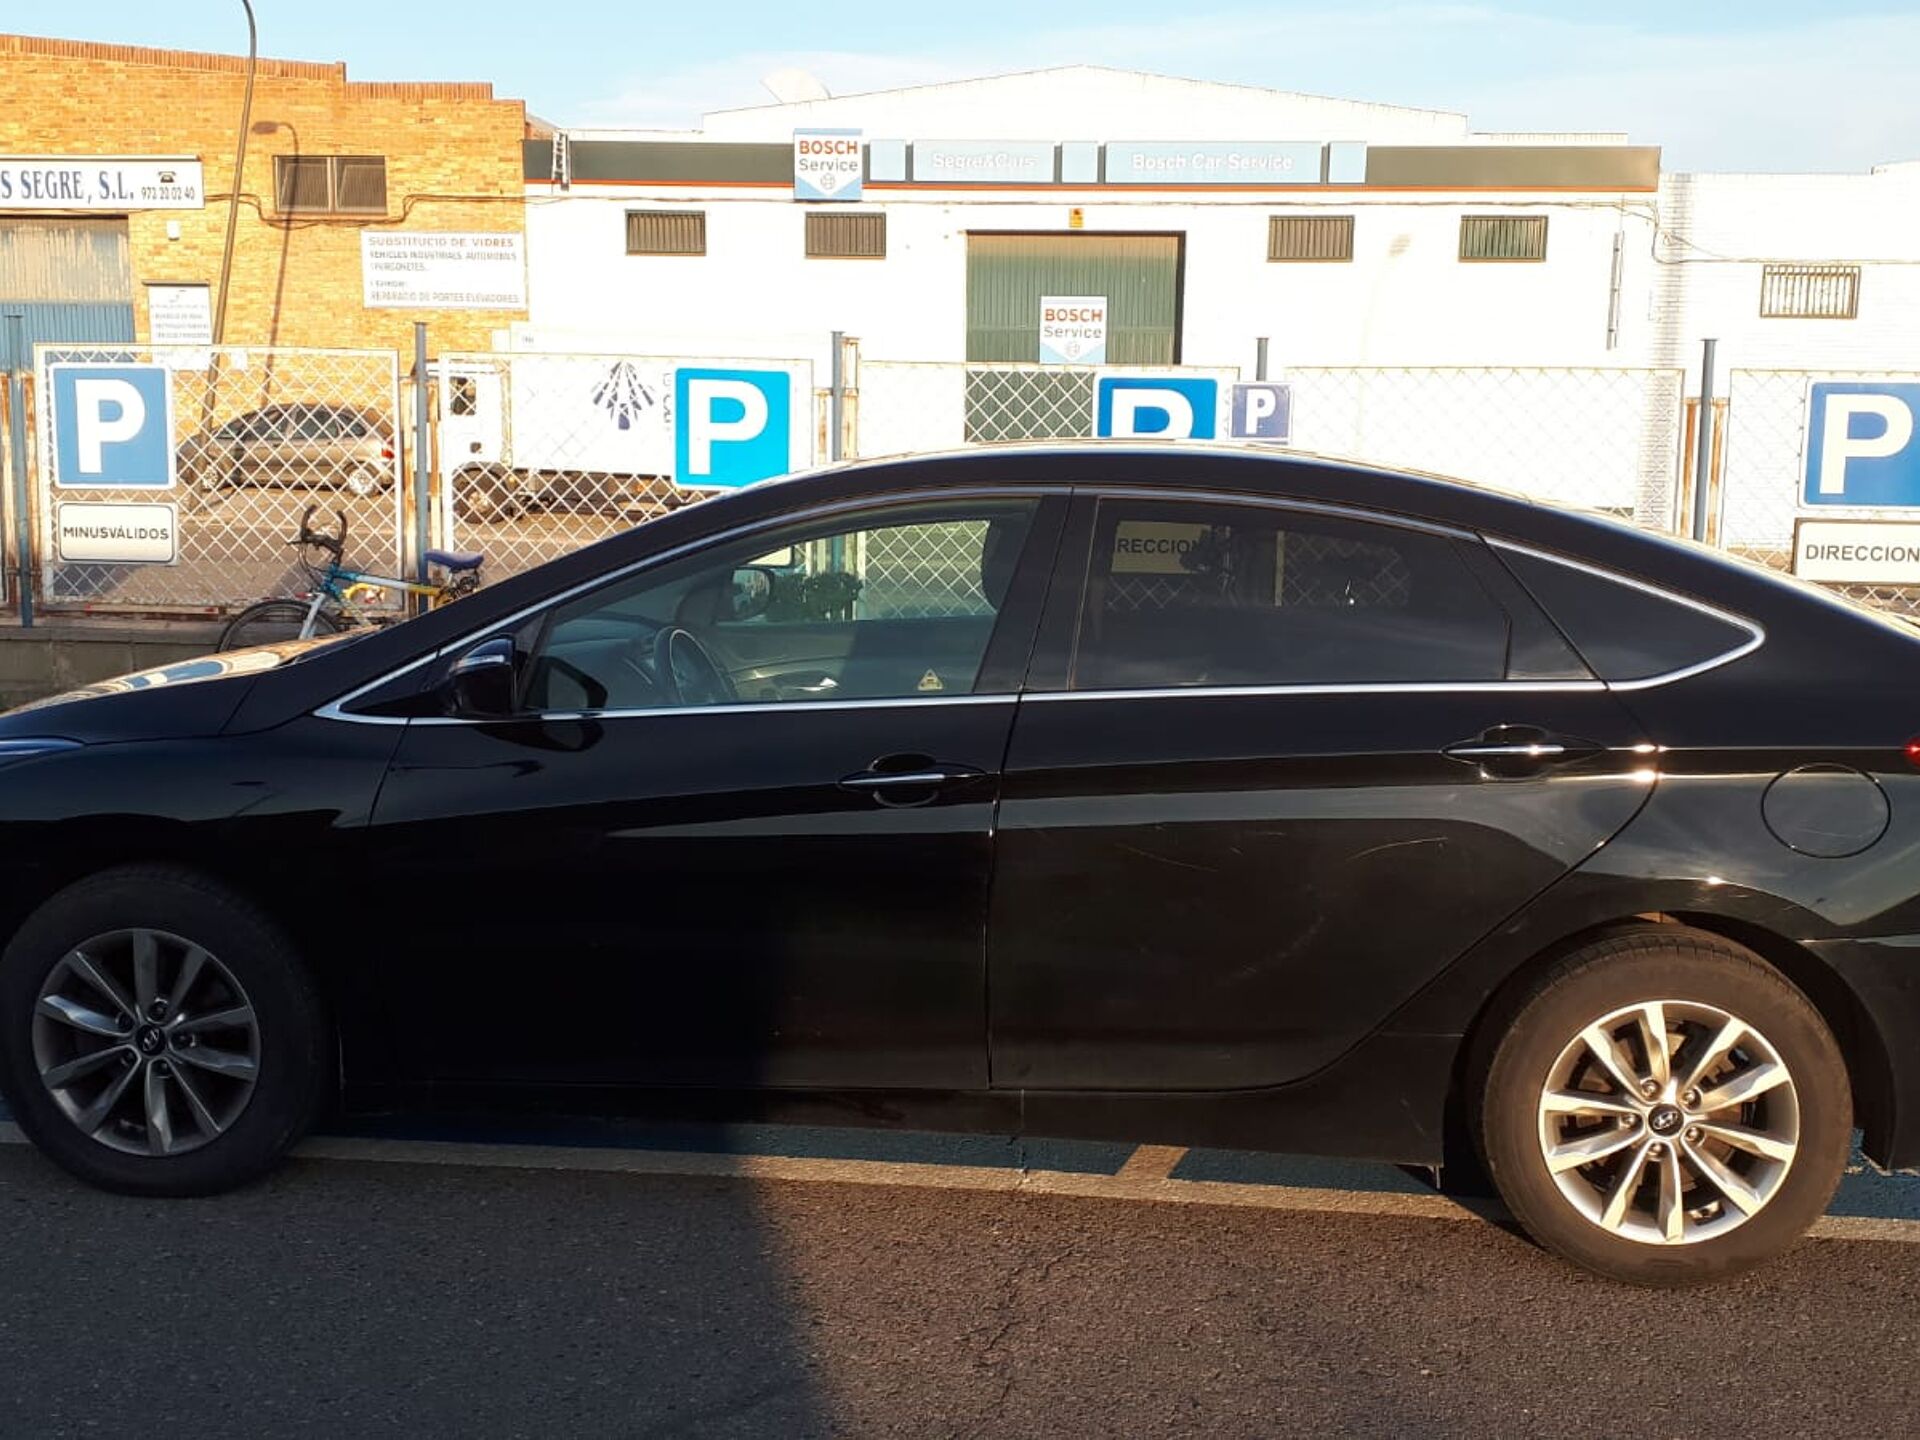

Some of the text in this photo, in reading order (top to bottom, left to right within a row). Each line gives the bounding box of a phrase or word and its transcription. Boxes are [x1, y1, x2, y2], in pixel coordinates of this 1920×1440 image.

[799, 140, 858, 155] BOSCH
[799, 158, 858, 172] Service
[1132, 153, 1293, 171] Bosch Car Service
[99, 170, 135, 200] S.L.
[1044, 308, 1103, 323] BOSCH
[1044, 326, 1102, 339] Service
[1245, 388, 1276, 435] P
[75, 378, 146, 474] P
[688, 379, 768, 475] P
[1819, 393, 1914, 495] P
[63, 526, 170, 541] MINUSVÁLIDOS
